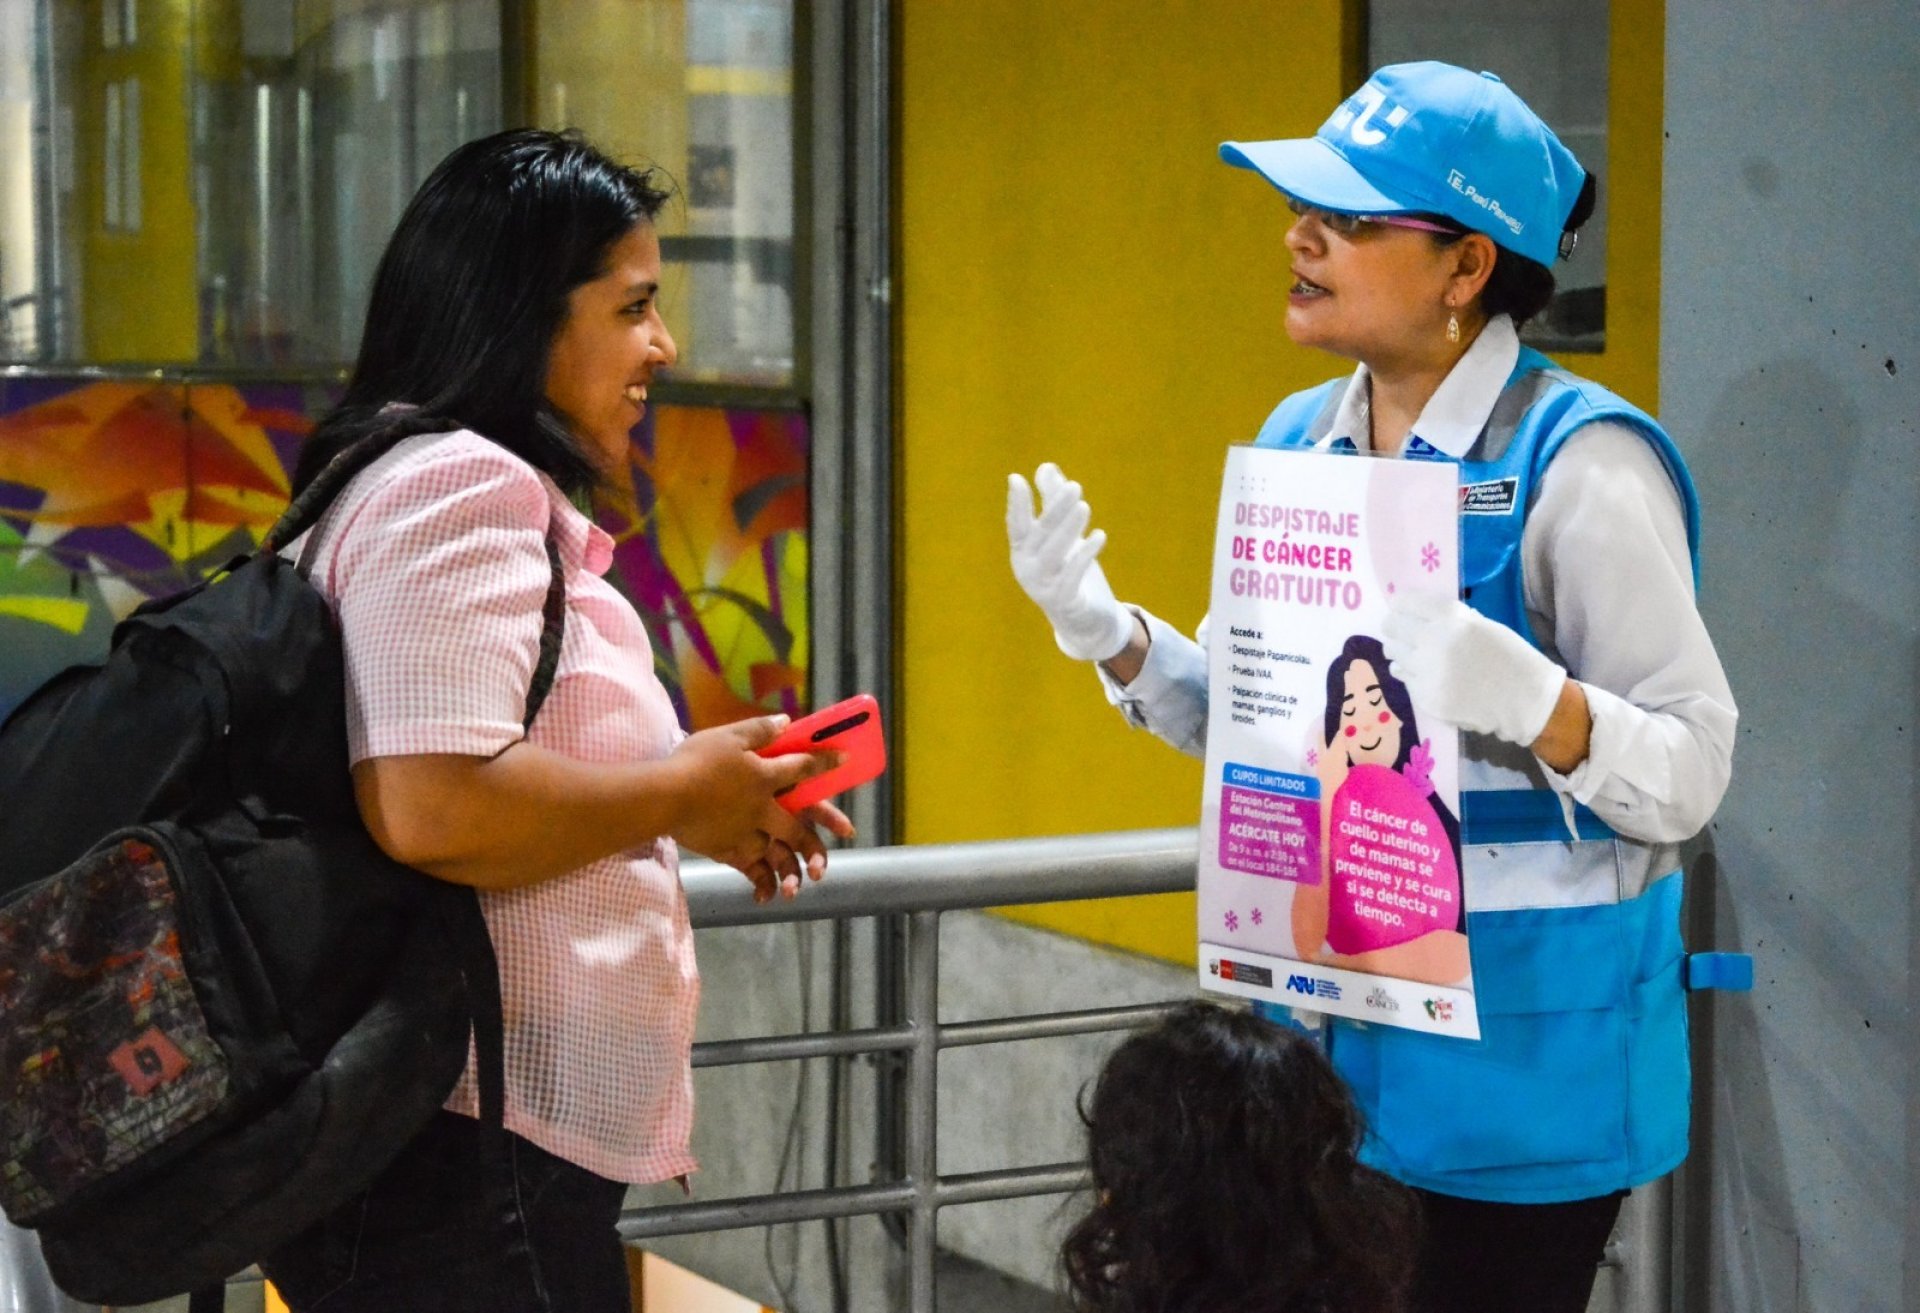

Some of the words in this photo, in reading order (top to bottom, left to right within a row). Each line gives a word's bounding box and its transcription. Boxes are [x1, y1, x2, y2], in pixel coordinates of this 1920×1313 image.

[1235, 502, 1360, 537] DESPISTAJE
[1232, 536, 1257, 561] DE
[1263, 531, 1352, 572] CÁNCER
[1230, 567, 1362, 611] GRATUITO
[1230, 625, 1255, 639] Accede
[1232, 644, 1266, 660] Despistaje
[1232, 664, 1255, 678] Prueba
[1257, 704, 1286, 717] ganglios
[1288, 695, 1298, 705] de
[1232, 769, 1258, 783] CUPOS
[1259, 774, 1306, 792] LIMITADOS
[1230, 791, 1263, 807] Estación
[1263, 798, 1296, 813] Central
[1229, 805, 1242, 815] del
[1242, 806, 1303, 826] Metropolitano
[1349, 801, 1362, 817] El
[1363, 805, 1408, 830] cáncer
[1410, 819, 1428, 836] de
[1229, 822, 1281, 844] ACÉRCATE
[1282, 832, 1306, 848] HOY
[1339, 821, 1379, 842] cuello
[1381, 834, 1430, 856] uterino
[1432, 846, 1441, 864] y
[1349, 842, 1366, 858] de
[1368, 849, 1416, 872] mamas
[1418, 862, 1433, 877] se
[1335, 859, 1391, 885] previene
[1394, 873, 1404, 890] y
[1405, 878, 1420, 893] se
[1422, 882, 1452, 902] cura
[1346, 879, 1358, 894] si
[1359, 884, 1374, 900] se
[1376, 889, 1427, 914] detecta
[1428, 905, 1438, 917] a
[1354, 899, 1405, 928] tiempo.
[1286, 973, 1315, 995] ATU
